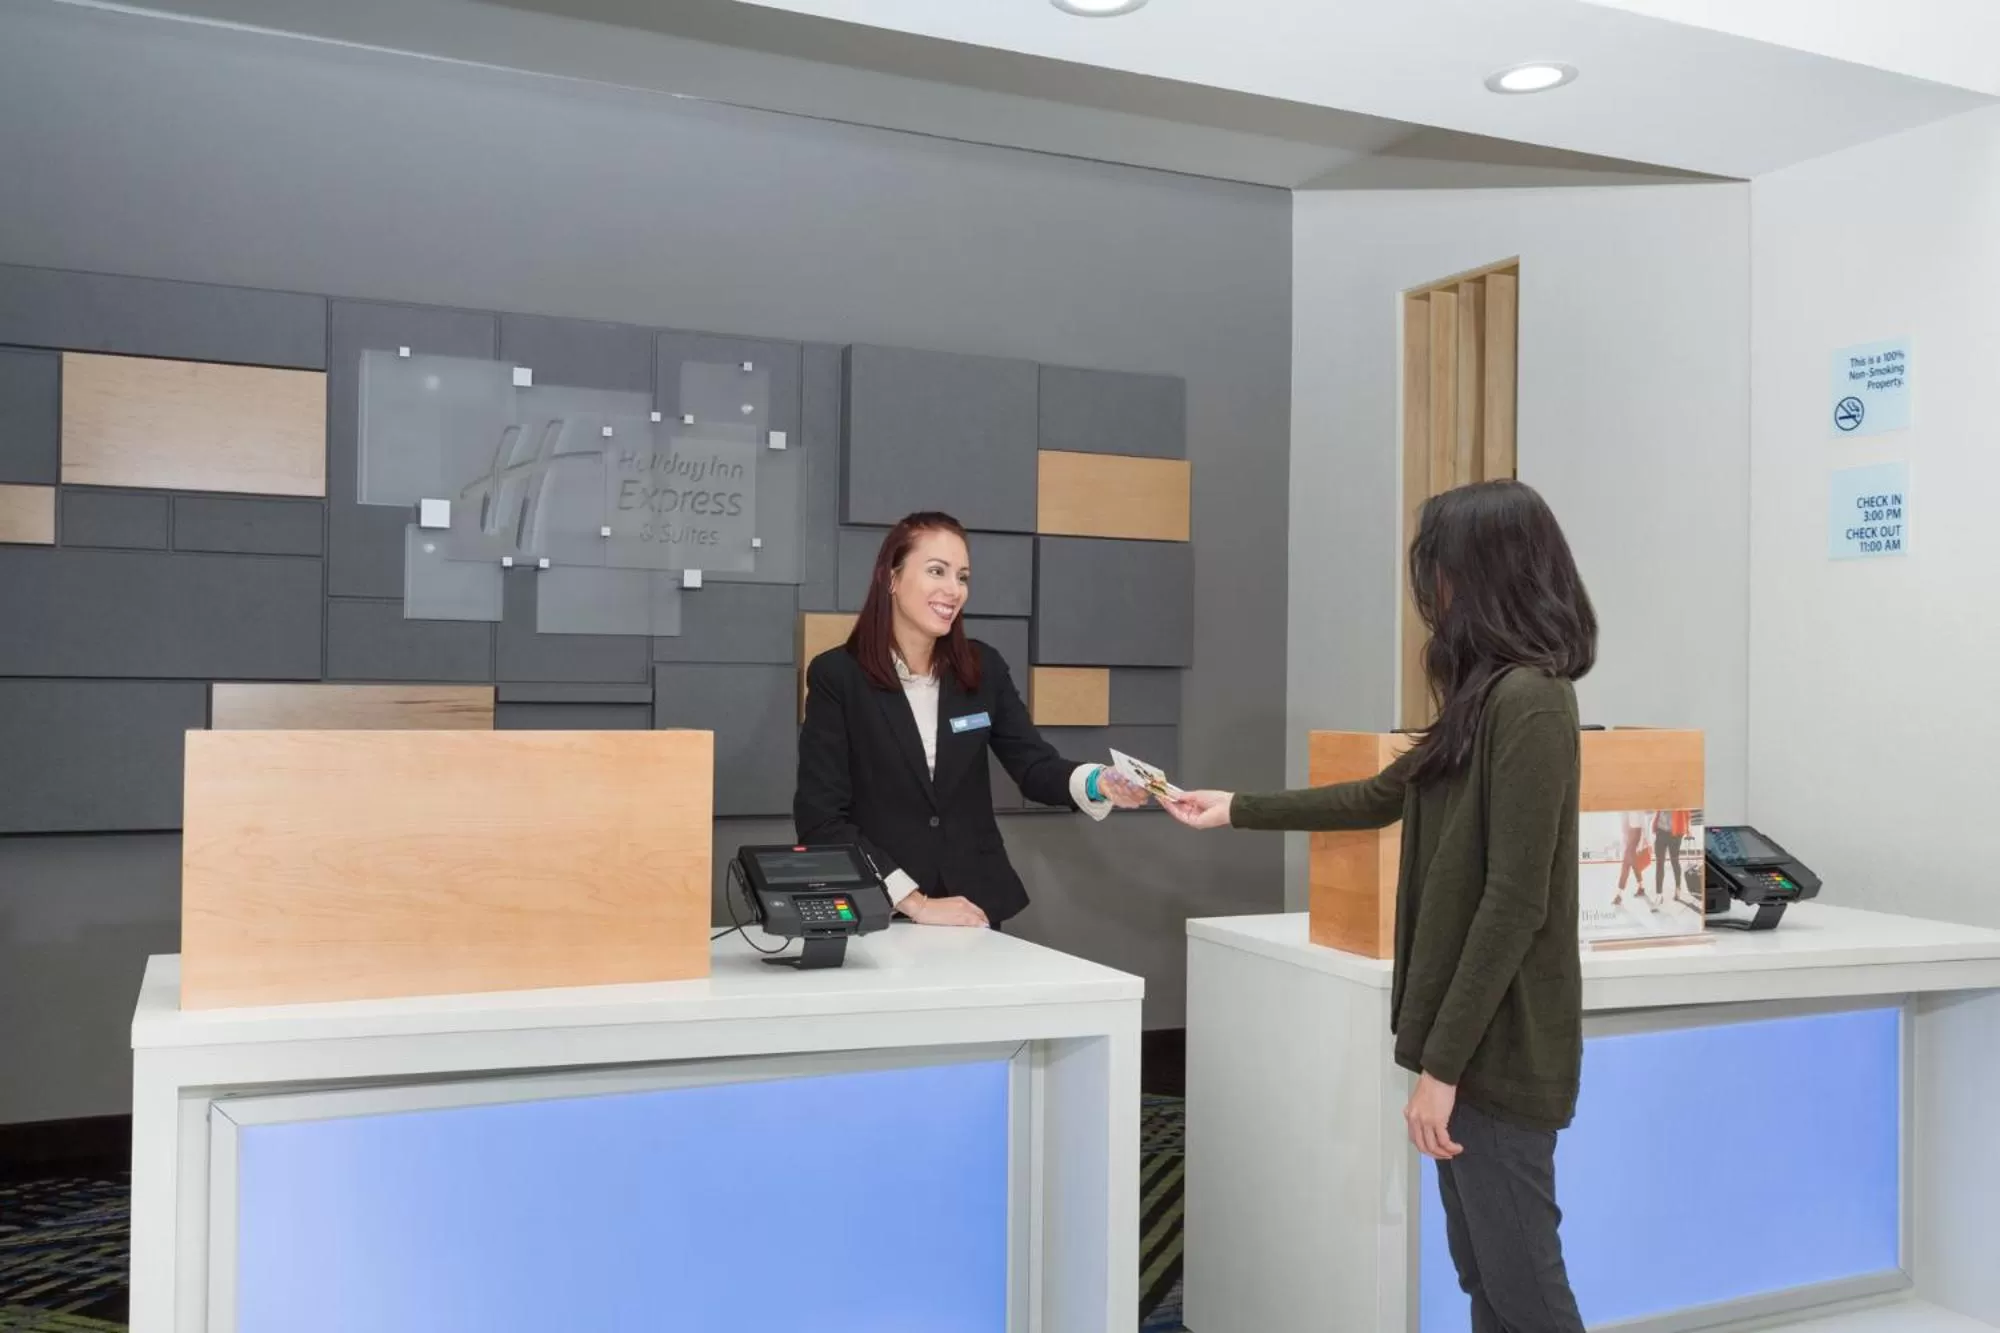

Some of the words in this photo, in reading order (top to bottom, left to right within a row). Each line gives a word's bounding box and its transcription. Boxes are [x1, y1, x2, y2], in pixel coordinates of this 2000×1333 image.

[1850, 357, 1866, 367] This
[1884, 350, 1904, 361] 100%
[1849, 365, 1904, 380] Non-Smoking
[619, 451, 706, 482] Holiday
[709, 455, 744, 478] Inn
[618, 479, 743, 516] Express
[1856, 495, 1888, 508] CHECK
[1891, 494, 1902, 505] IN
[1863, 510, 1884, 522] 3:00
[1886, 508, 1902, 520] PM
[639, 523, 652, 542] &
[659, 523, 720, 545] Suites
[1845, 527, 1877, 540] CHECK
[1880, 525, 1902, 537] OUT
[1860, 541, 1882, 553] 11:00
[1884, 539, 1901, 551] AM
